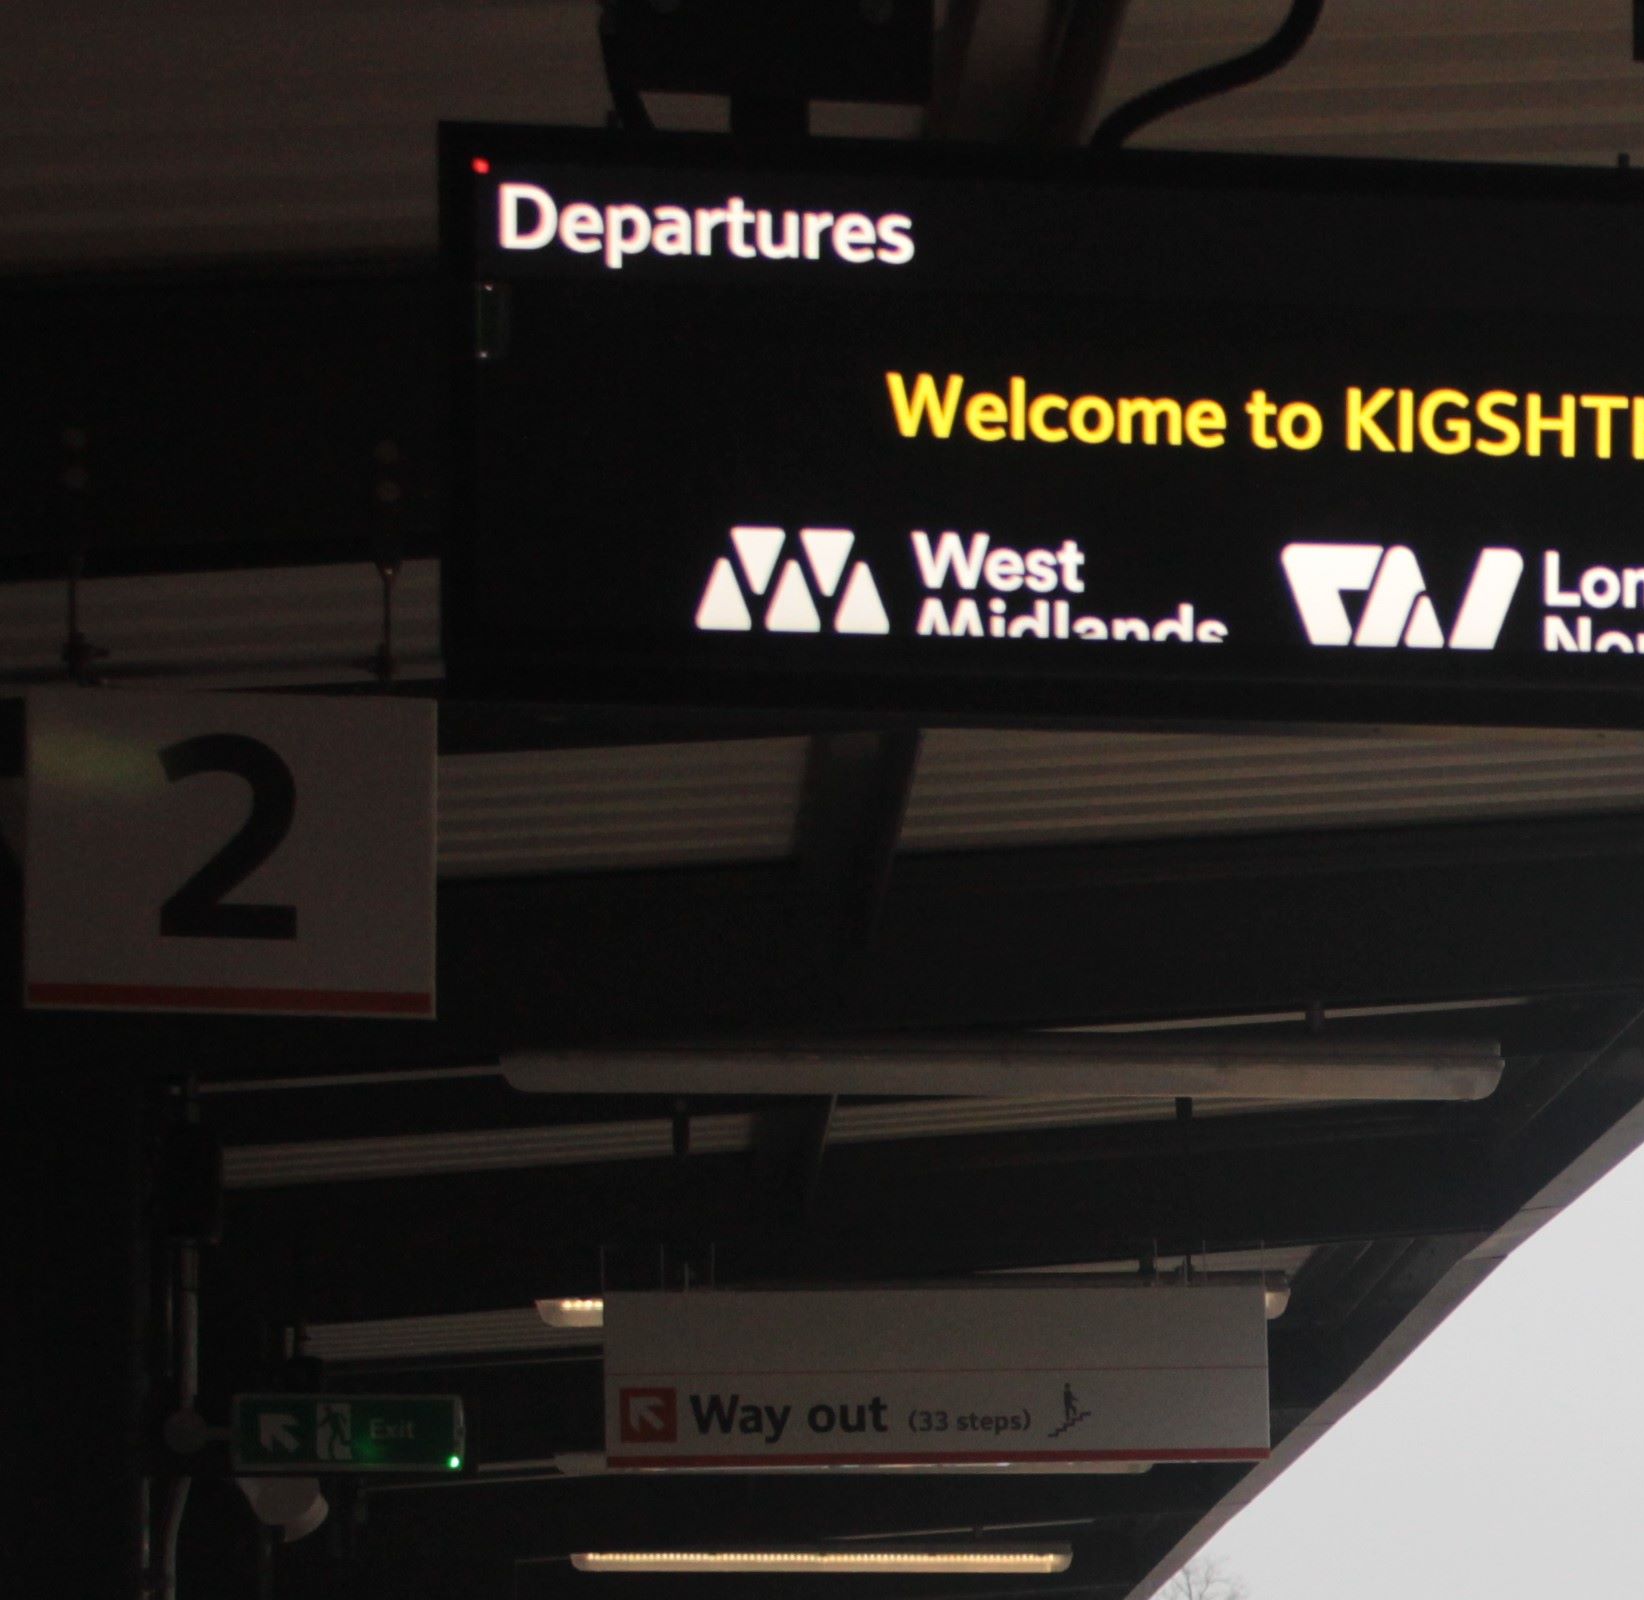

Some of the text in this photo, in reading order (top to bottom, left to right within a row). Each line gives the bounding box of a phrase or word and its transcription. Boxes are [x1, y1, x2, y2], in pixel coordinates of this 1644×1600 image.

[499, 182, 915, 269] Departures
[885, 371, 1227, 449] Welcome
[1243, 389, 1324, 451] to
[910, 530, 1085, 594] West
[157, 732, 297, 941] 2
[369, 1418, 416, 1440] Exit
[689, 1393, 1032, 1444] Way out (33 steps)
